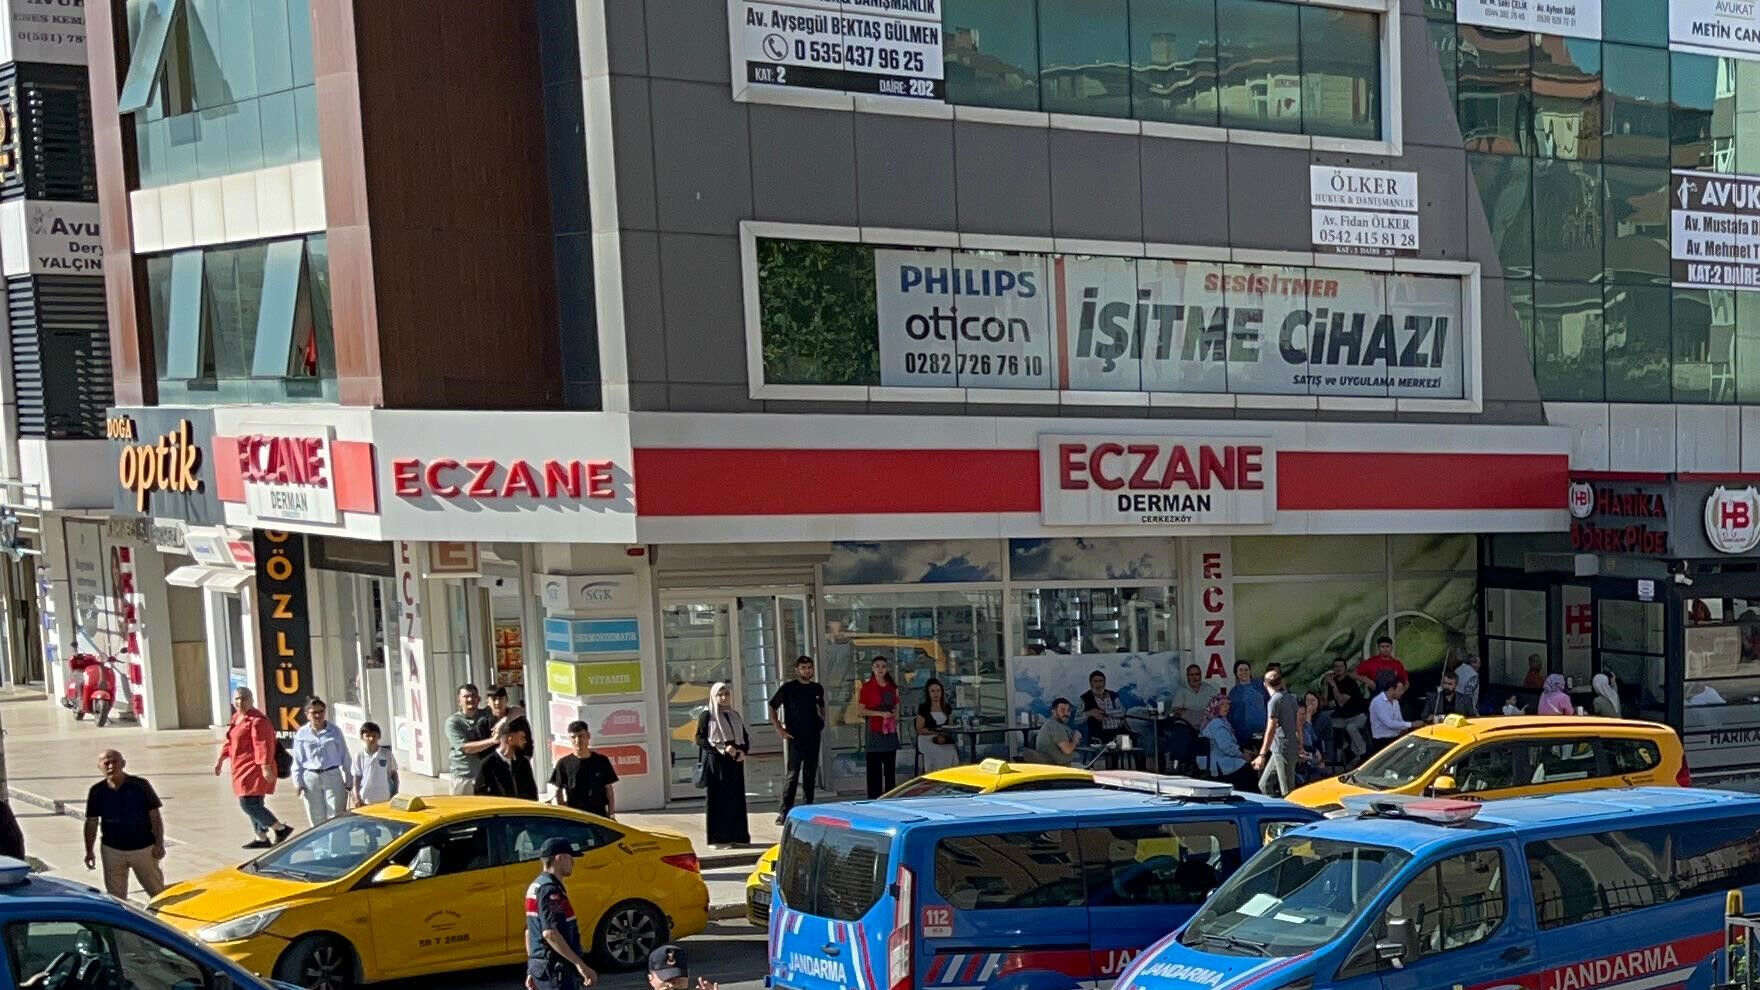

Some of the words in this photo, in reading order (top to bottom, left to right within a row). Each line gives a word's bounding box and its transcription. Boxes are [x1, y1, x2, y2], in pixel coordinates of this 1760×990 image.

[1715, 1, 1754, 16] AVUKAT
[746, 8, 767, 28] Av.
[771, 10, 828, 36] Ayşegül
[832, 17, 882, 42] BEKTAŞ
[885, 22, 939, 46] GÜLMEN
[1692, 20, 1731, 40] METİN
[794, 40, 805, 60] 0
[811, 41, 842, 64] 535
[845, 45, 874, 68] 437
[878, 49, 900, 70] 96
[903, 51, 924, 73] 25
[776, 67, 786, 84] 2
[910, 80, 935, 97] 202
[1330, 170, 1398, 196] ÖLKER
[1340, 215, 1369, 227] Fidan
[1372, 214, 1410, 230] ÖLKER
[1685, 215, 1701, 232] Av.
[1703, 216, 1749, 235] Mustafa
[1320, 229, 1352, 244] 0542
[1355, 231, 1378, 245] 415
[1381, 233, 1396, 246] 81
[1401, 234, 1416, 247] 28
[1686, 239, 1703, 256] Av.
[1705, 240, 1751, 259] Mehmet
[900, 265, 1037, 298] PHILIPS
[1688, 264, 1722, 284] KAT:2
[905, 306, 1031, 342] oticon
[1076, 287, 1265, 373] İŞİTME
[905, 352, 951, 374] 0282
[957, 354, 992, 374] 726
[997, 355, 1019, 376] 76
[1025, 355, 1043, 376] 10
[1292, 375, 1322, 387] SATIŞ
[1325, 377, 1337, 386] ve
[1340, 376, 1395, 387] UYGULAMA
[1398, 376, 1442, 388] MERKEZİ
[119, 418, 199, 513] optik
[1059, 443, 1265, 491] ECZANE
[392, 457, 616, 499] ECZANE
[271, 490, 308, 512] DERMAN
[1118, 494, 1211, 512] DERMAN
[1141, 515, 1192, 524] ÇERKEZKÖY
[1720, 501, 1750, 529] HB
[586, 589, 613, 601] SGK
[1203, 553, 1228, 697] ECZA
[926, 909, 949, 925] 112
[789, 951, 848, 984] JANDARMA
[1140, 962, 1226, 987] JANDARMA
